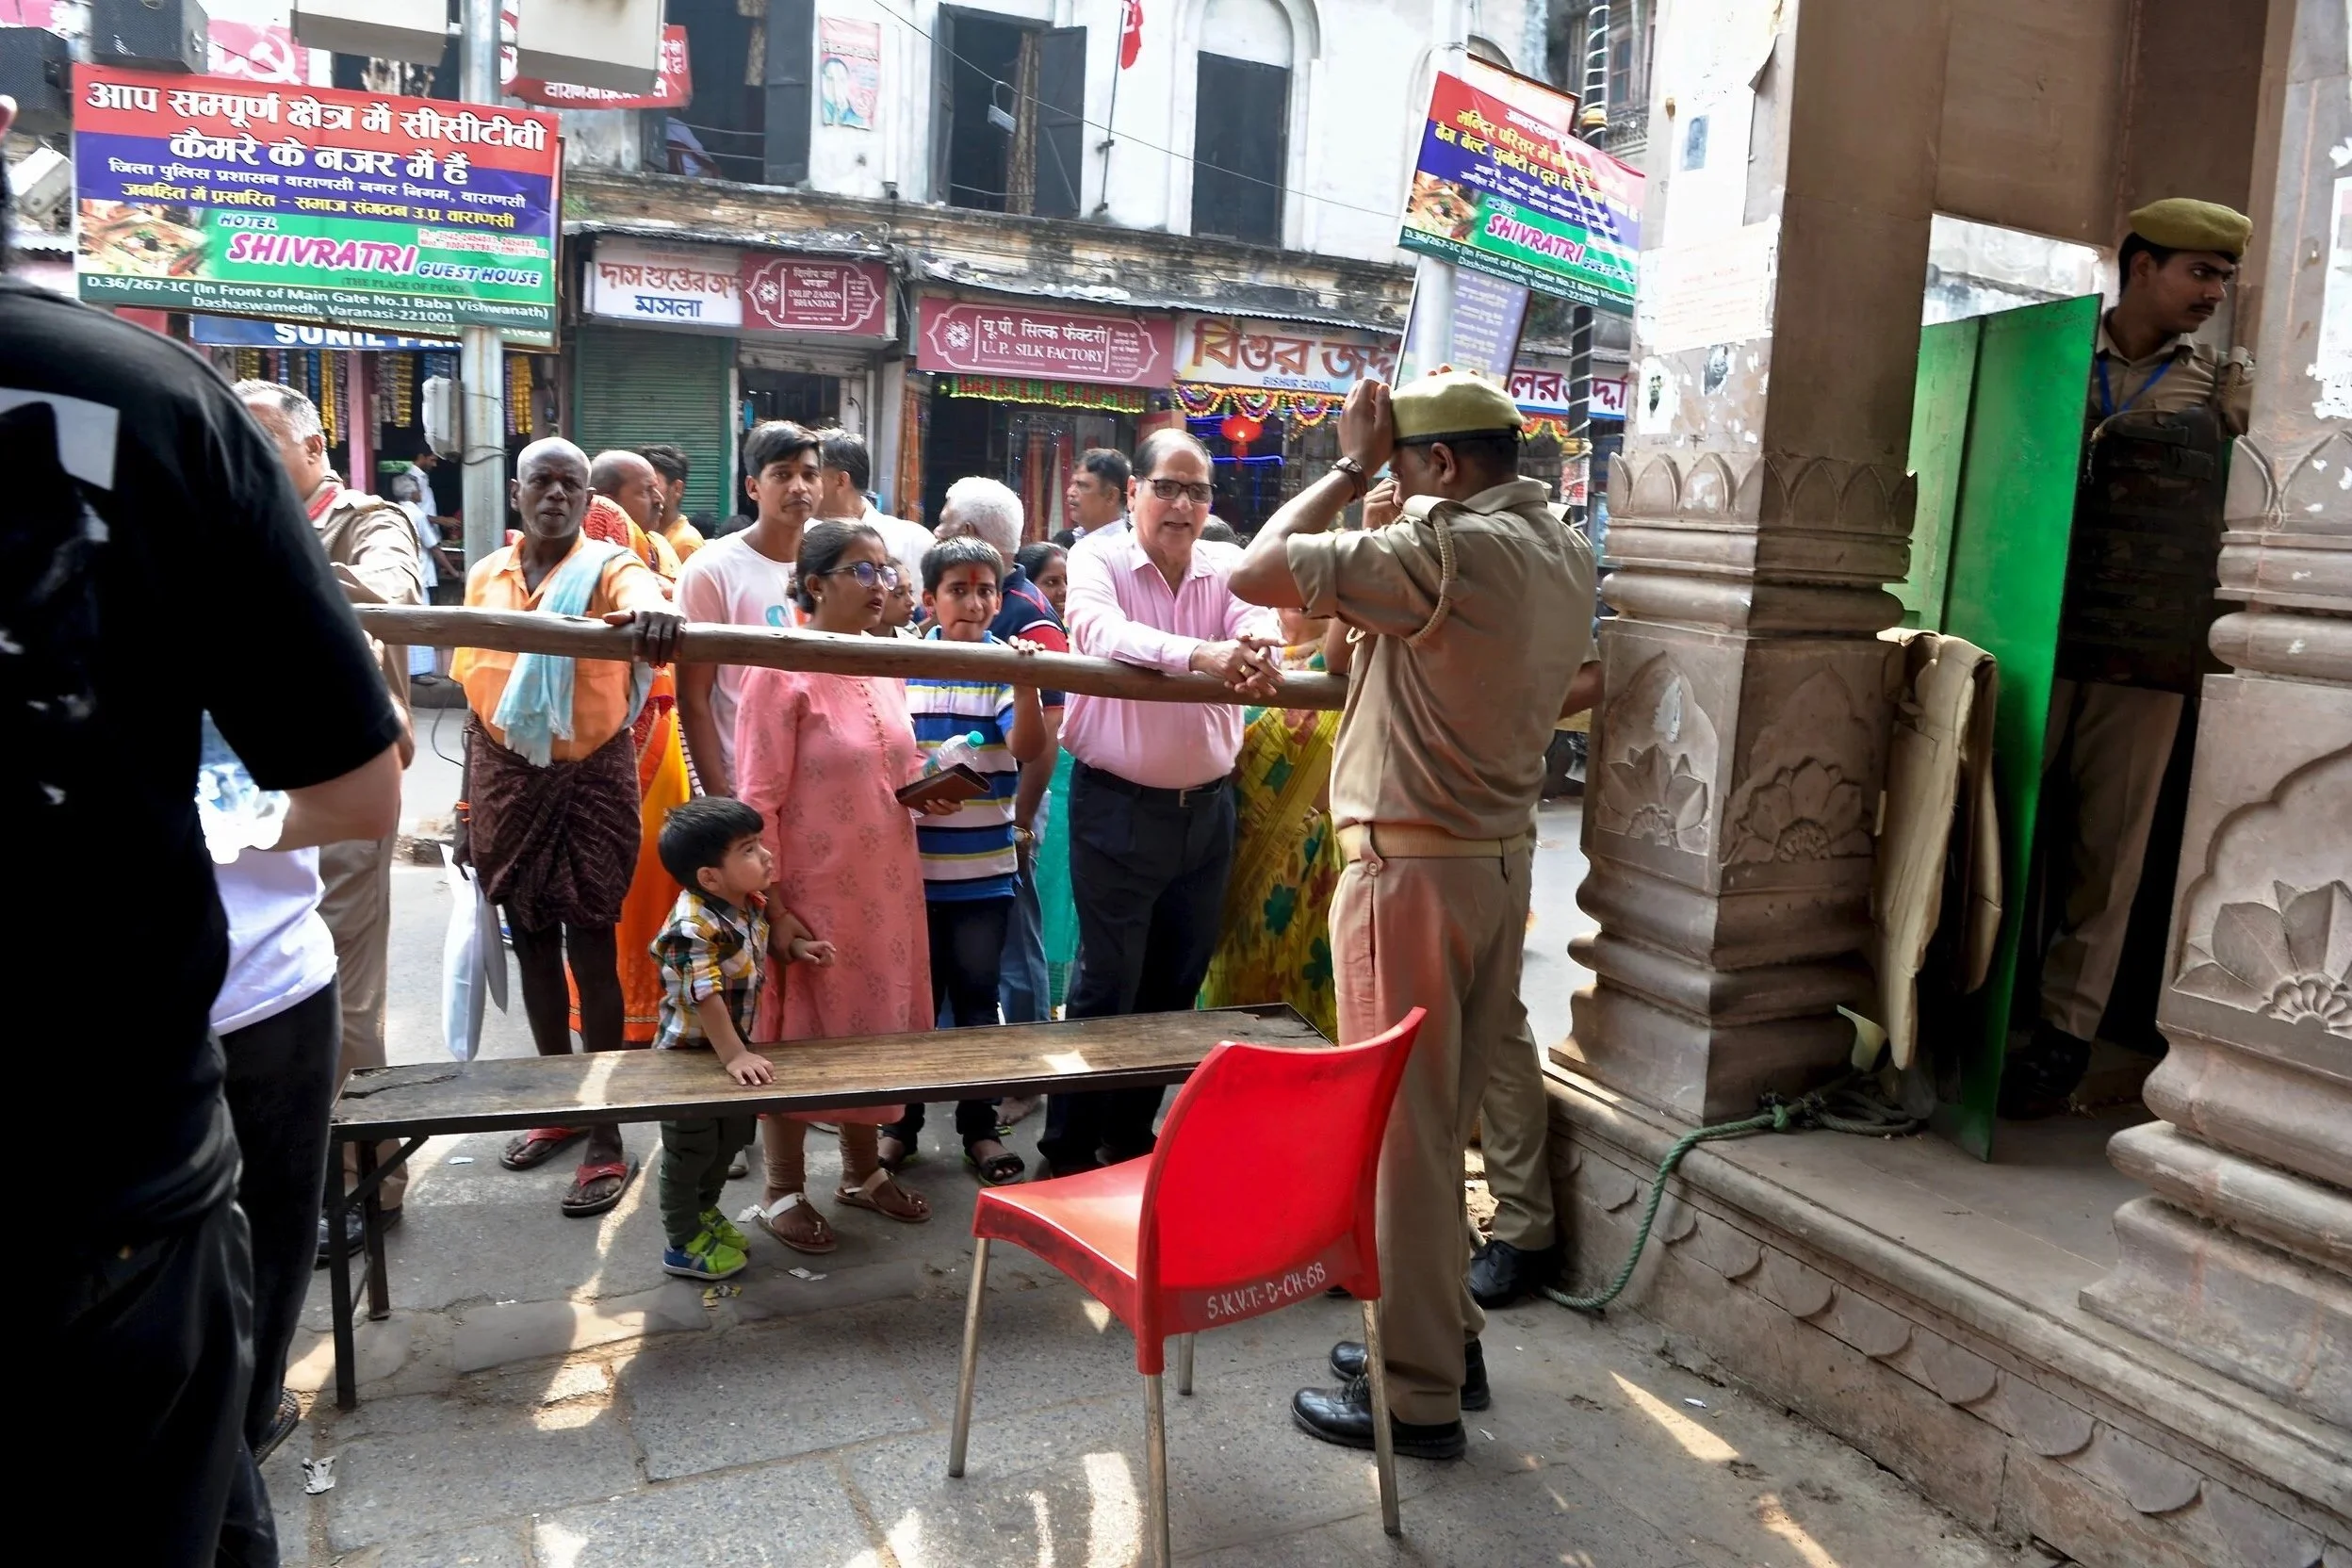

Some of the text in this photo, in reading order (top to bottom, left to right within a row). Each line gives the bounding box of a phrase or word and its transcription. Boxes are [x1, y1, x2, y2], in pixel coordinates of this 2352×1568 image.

[86, 82, 547, 151] आप सम्पूर्ण क्षेत्र में सीसीटीवी
[170, 127, 471, 185] कैमरे के नजर में हैं
[108, 157, 154, 176] जिला
[160, 162, 210, 180] पुलिस
[215, 170, 280, 186] प्रशासन
[286, 176, 354, 192] वाराणसी
[359, 182, 398, 196] नगर
[462, 191, 525, 209] वाराणसी
[122, 182, 187, 201] जनहित
[191, 186, 207, 202] में
[212, 190, 276, 207] प्रसारित
[294, 196, 347, 214] समाज
[351, 199, 407, 218] संगठन
[448, 209, 515, 228] वाराणसी
[220, 214, 277, 230] HOTEL
[1486, 214, 1584, 263] SHIVRATRI
[228, 233, 416, 273] SHIVRATRI
[418, 263, 540, 286] GUEST HOUSE
[598, 262, 645, 289] দাস
[1475, 250, 1499, 266] Front
[1499, 260, 1511, 269] of
[1511, 261, 1533, 276] Main
[1534, 270, 1556, 284] Gate
[1556, 276, 1576, 289] No.1
[87, 277, 549, 320] D.36/267-1C (In Front of Main Gate No.1 Baba Vishwanath)
[635, 294, 703, 318] মসলা
[788, 289, 812, 299] DILIP
[792, 298, 838, 308] BHANDAR
[191, 296, 455, 323] Dashaswamedh, Varanasi-221001
[274, 322, 386, 347] SUNIL
[1021, 318, 1060, 339] सिल्क
[982, 340, 996, 354] U.
[999, 341, 1010, 355] P.
[1015, 343, 1045, 358] SILK
[1047, 346, 1105, 363] FACTORY
